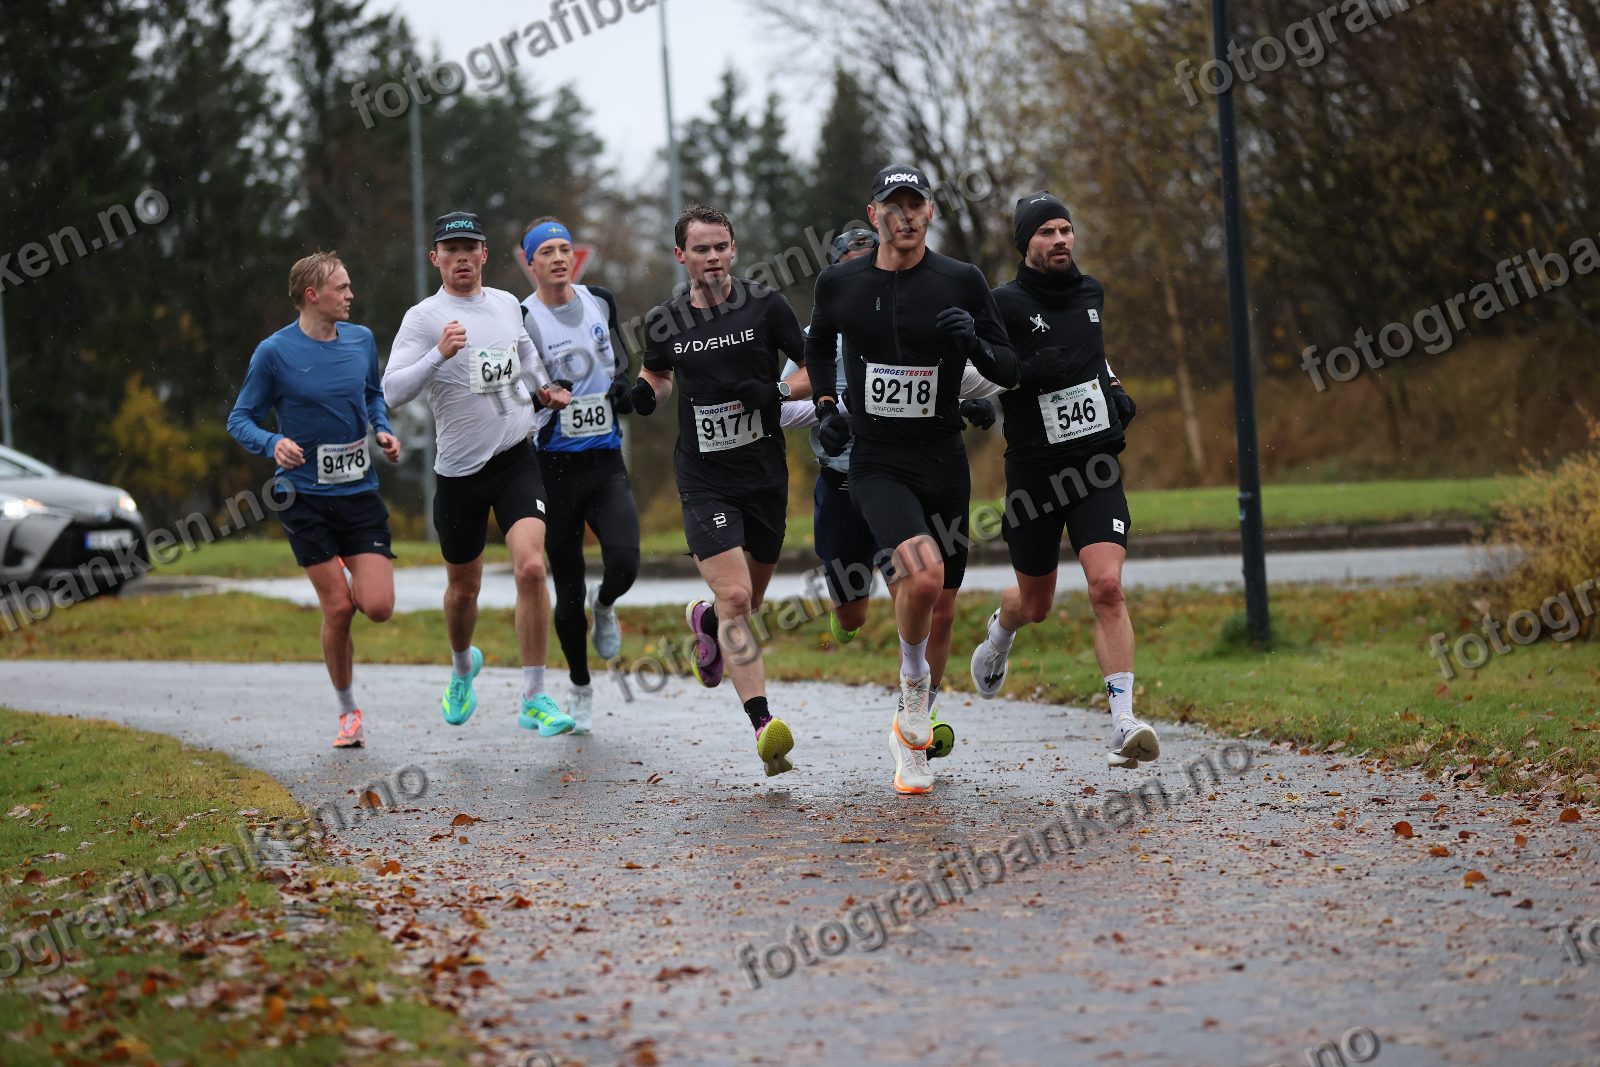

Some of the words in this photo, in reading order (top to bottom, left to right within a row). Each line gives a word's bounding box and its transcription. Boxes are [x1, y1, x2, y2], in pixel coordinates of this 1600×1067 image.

[884, 173, 918, 185] HOKA
[445, 220, 474, 231] HOKA
[481, 359, 512, 382] 614
[872, 367, 934, 377] NORGESTESTEN
[872, 377, 931, 405] 9218
[572, 406, 606, 429] 548
[701, 410, 754, 440] 9177
[1057, 397, 1096, 431] 546
[322, 448, 366, 475] 9478
